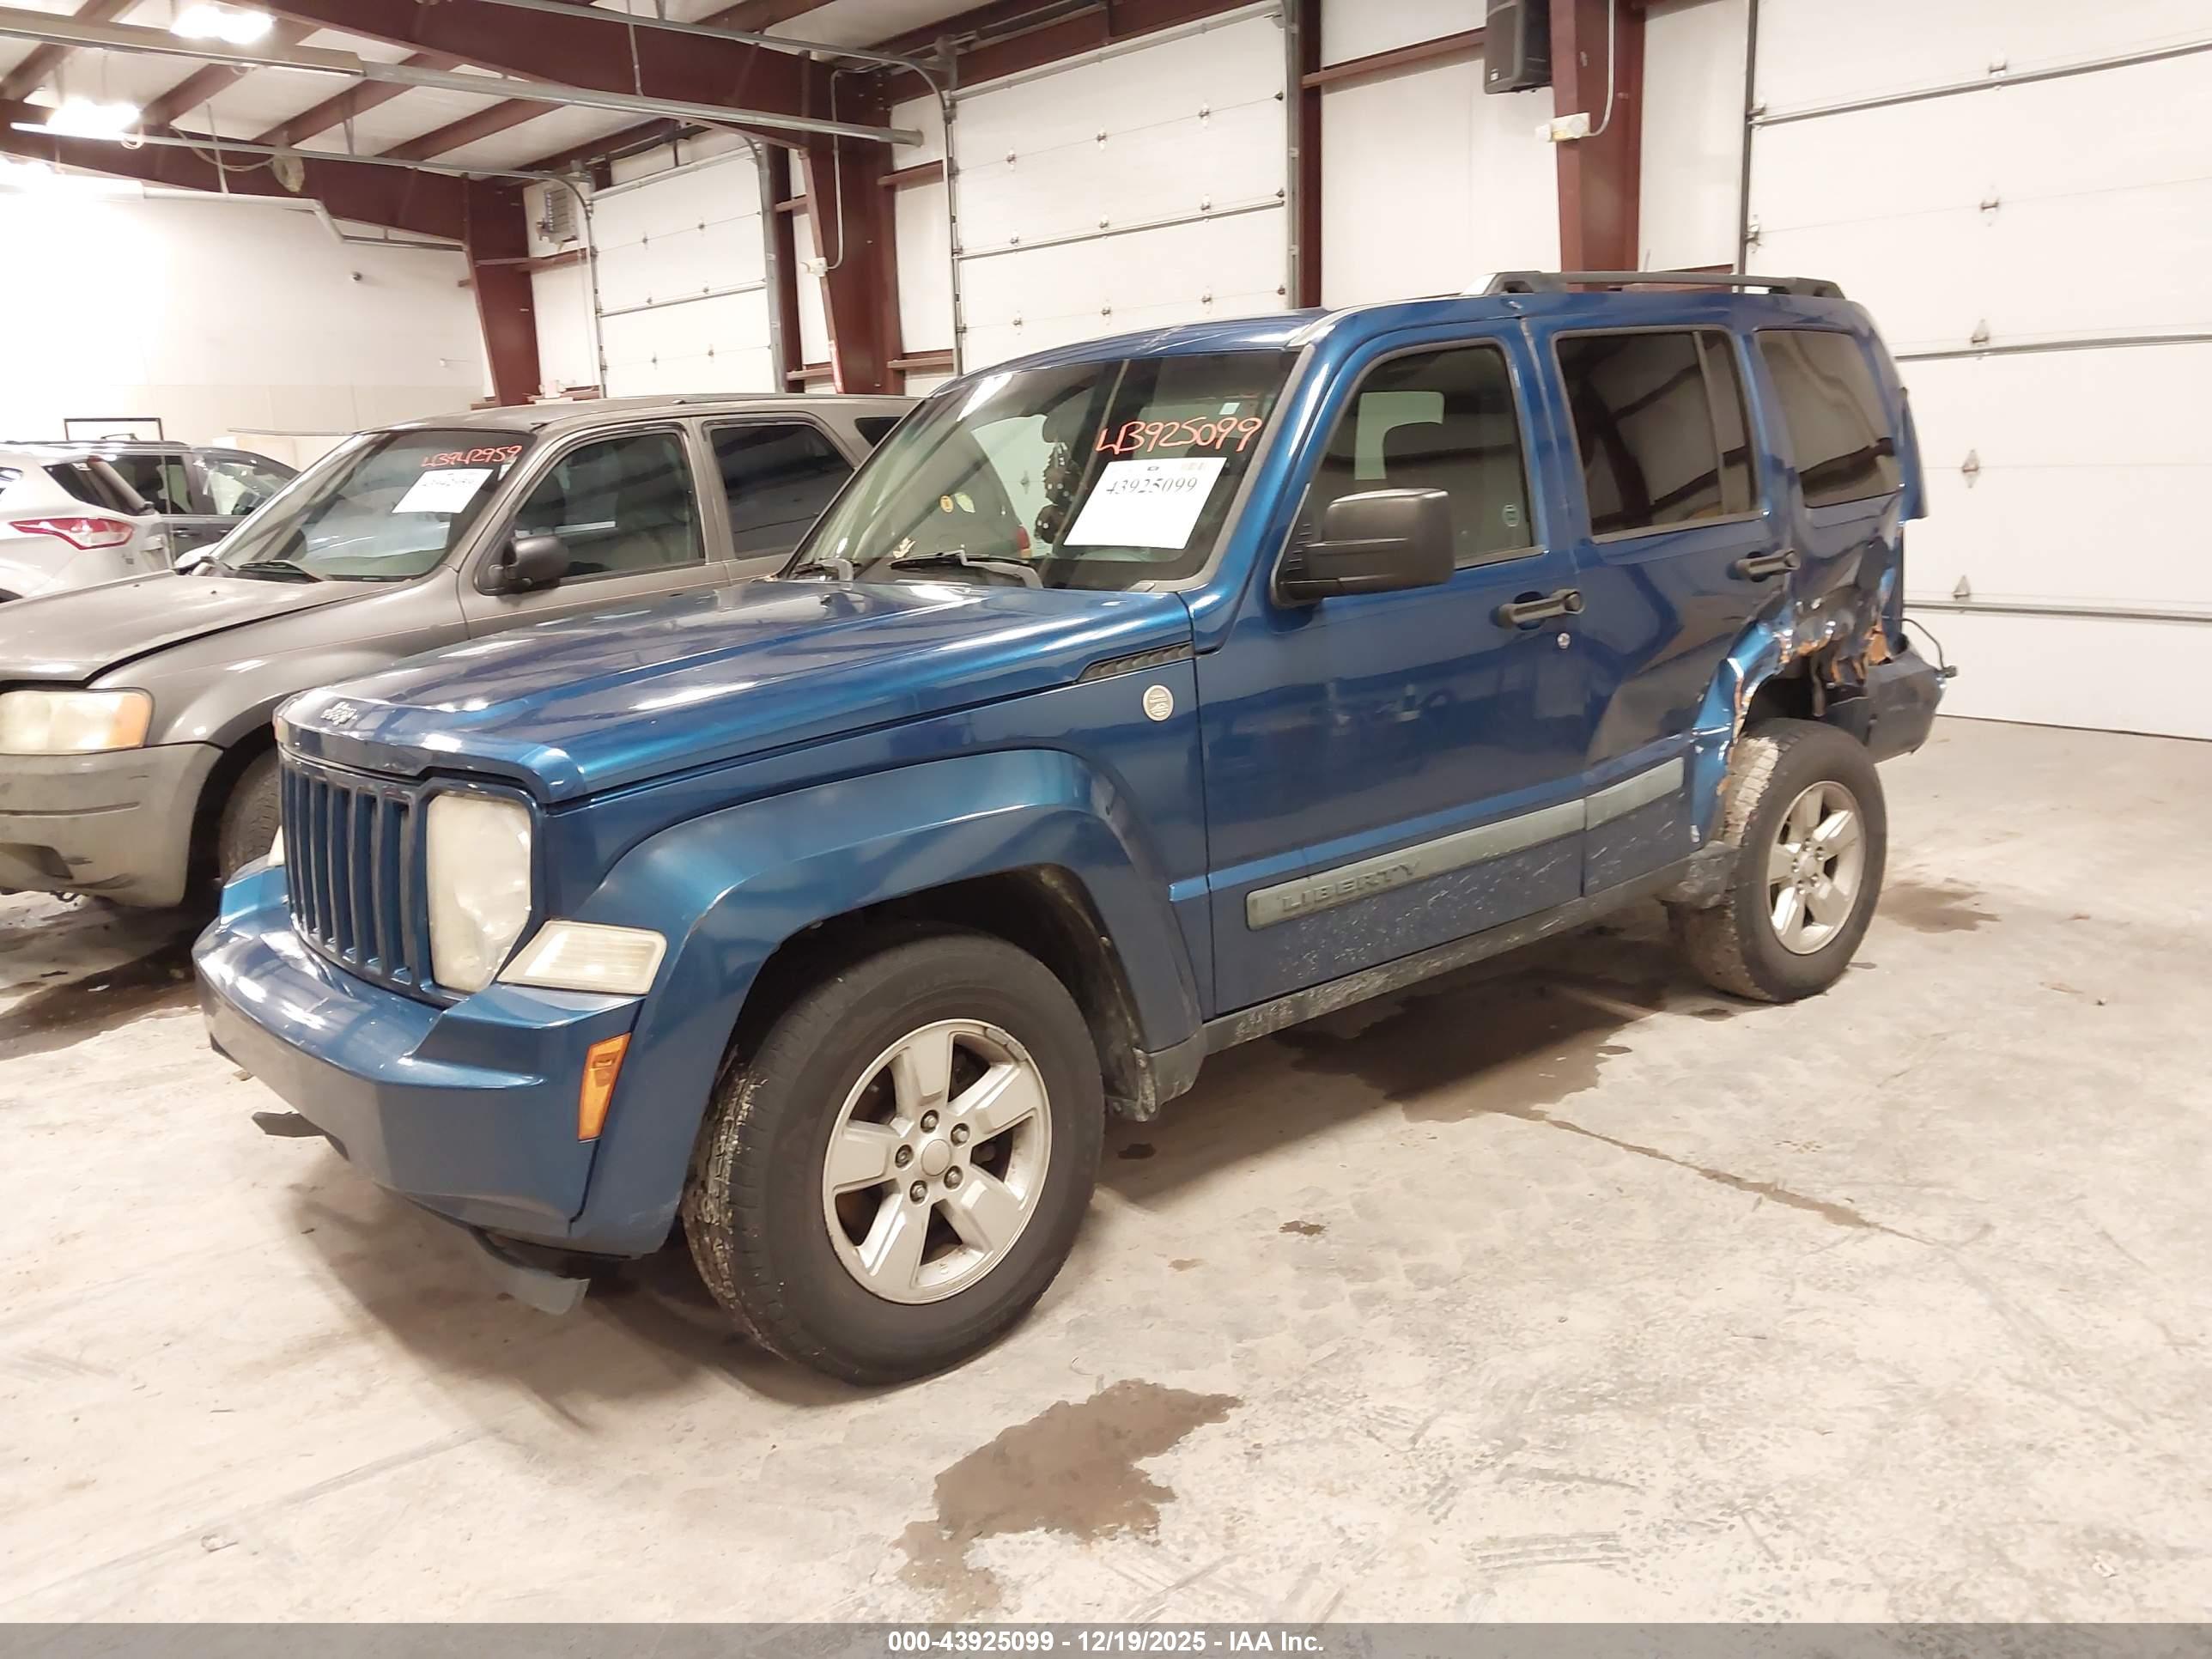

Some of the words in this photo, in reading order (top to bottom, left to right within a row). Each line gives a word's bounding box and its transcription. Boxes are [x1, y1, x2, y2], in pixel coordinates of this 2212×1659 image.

[1095, 416, 1263, 455] 43925099
[1105, 477, 1198, 495] 43925099
[1278, 860, 1421, 912] LIBERTY
